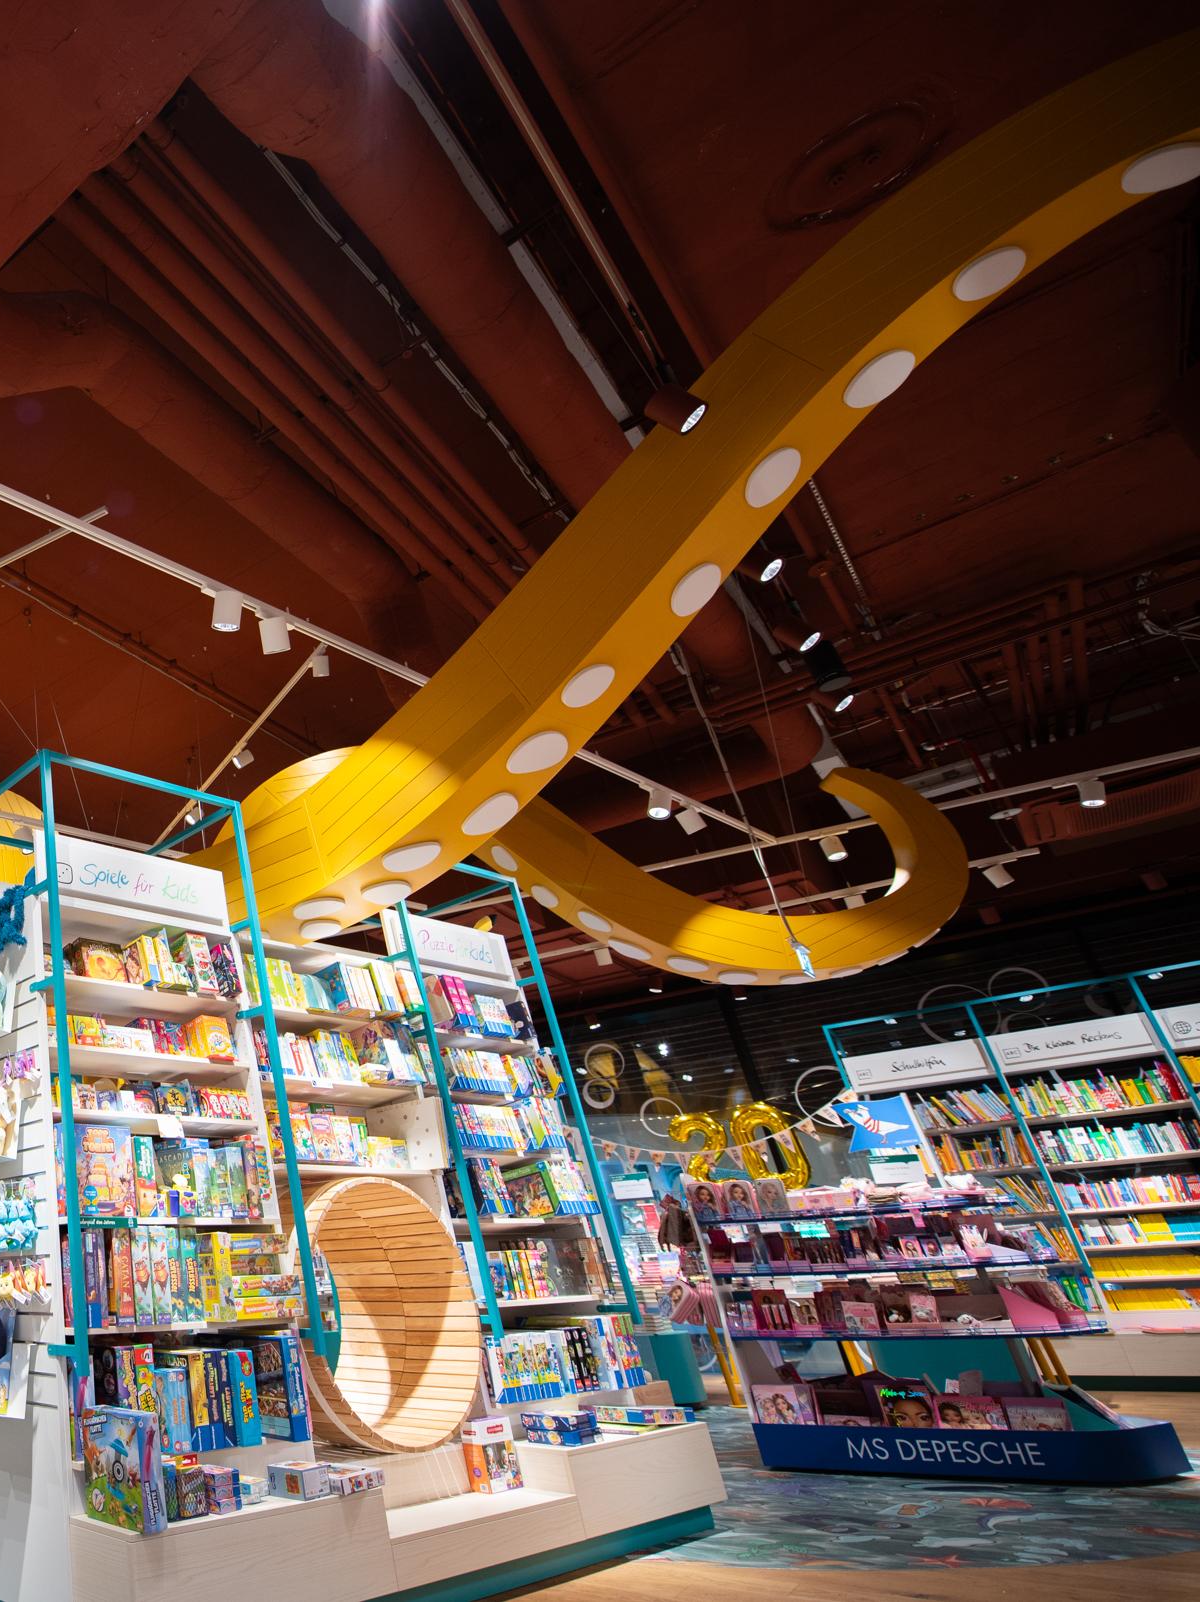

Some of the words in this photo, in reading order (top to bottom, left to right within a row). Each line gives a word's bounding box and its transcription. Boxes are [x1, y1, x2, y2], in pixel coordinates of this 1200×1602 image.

[80, 863, 129, 889] Spiele
[121, 1255, 130, 1289] CATAN
[846, 1436, 890, 1461] MS
[895, 1438, 1047, 1467] DEPESCHE
